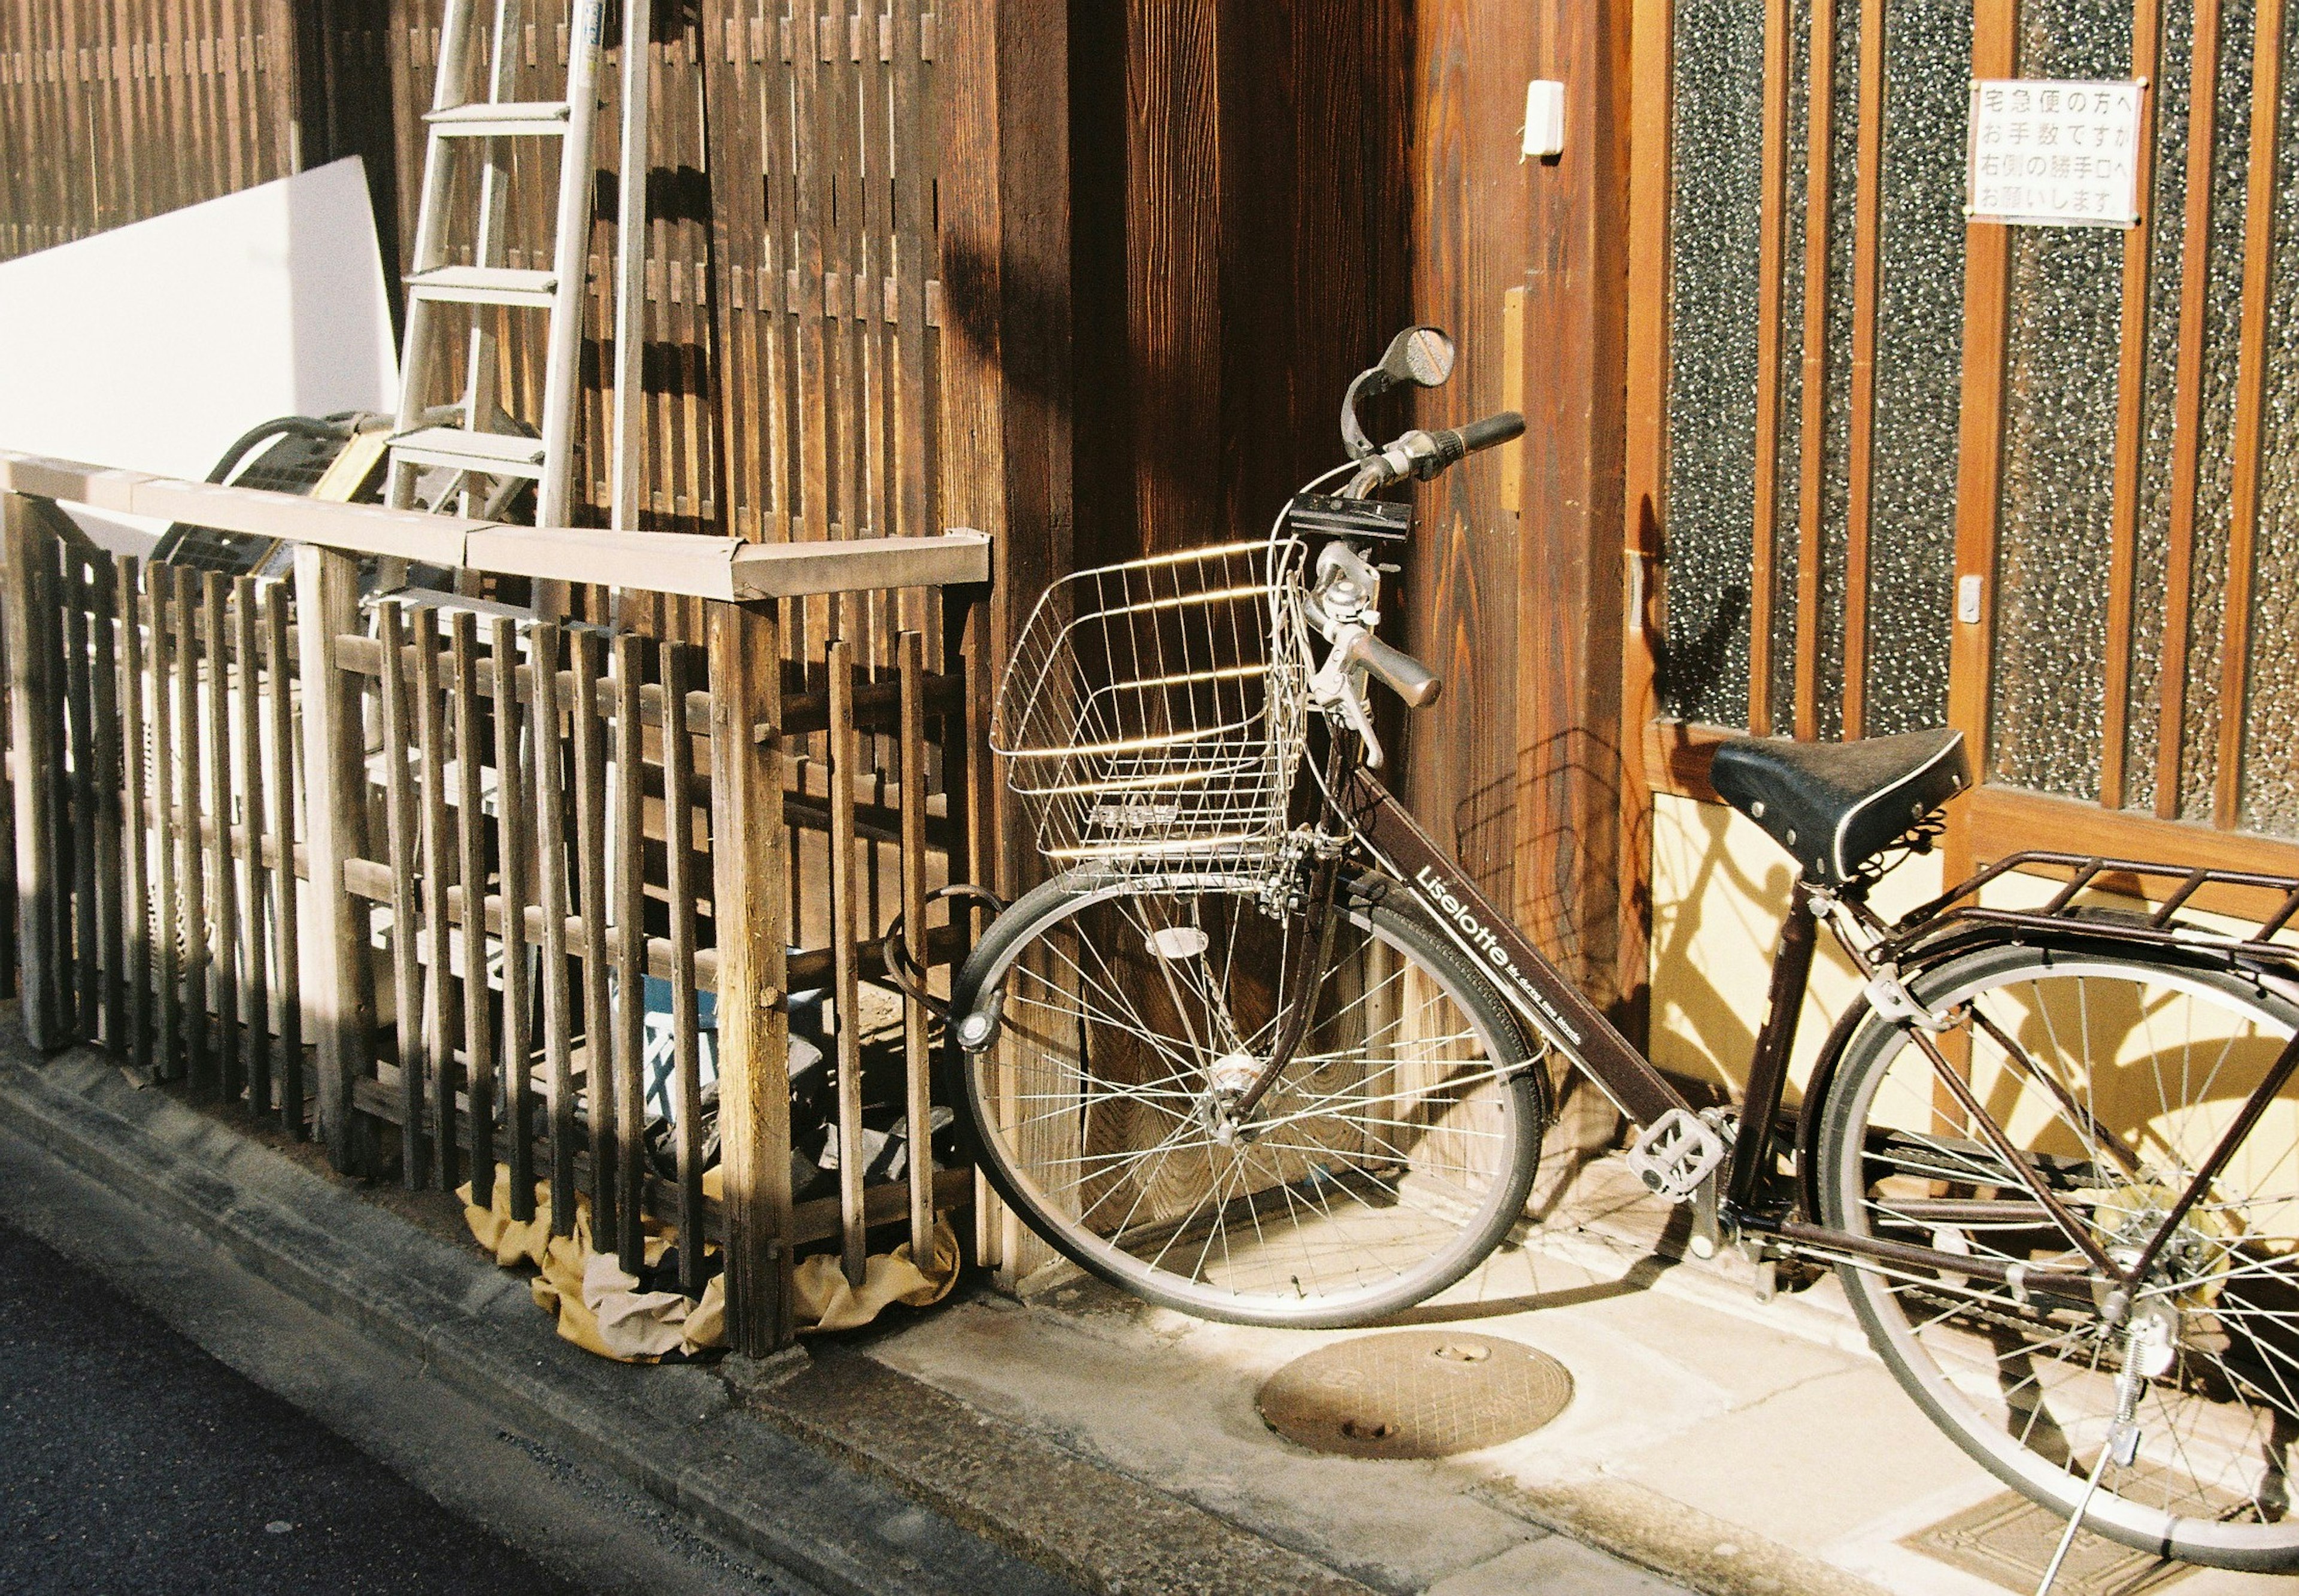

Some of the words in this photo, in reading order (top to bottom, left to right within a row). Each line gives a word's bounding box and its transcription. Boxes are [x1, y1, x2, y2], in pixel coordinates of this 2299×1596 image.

[1984, 89, 2132, 114] 宅急便の方へ
[1982, 122, 2130, 147] お手数ですが
[1980, 153, 2128, 179] 右側の勝手口へ
[1416, 866, 1509, 966] Liselotte
